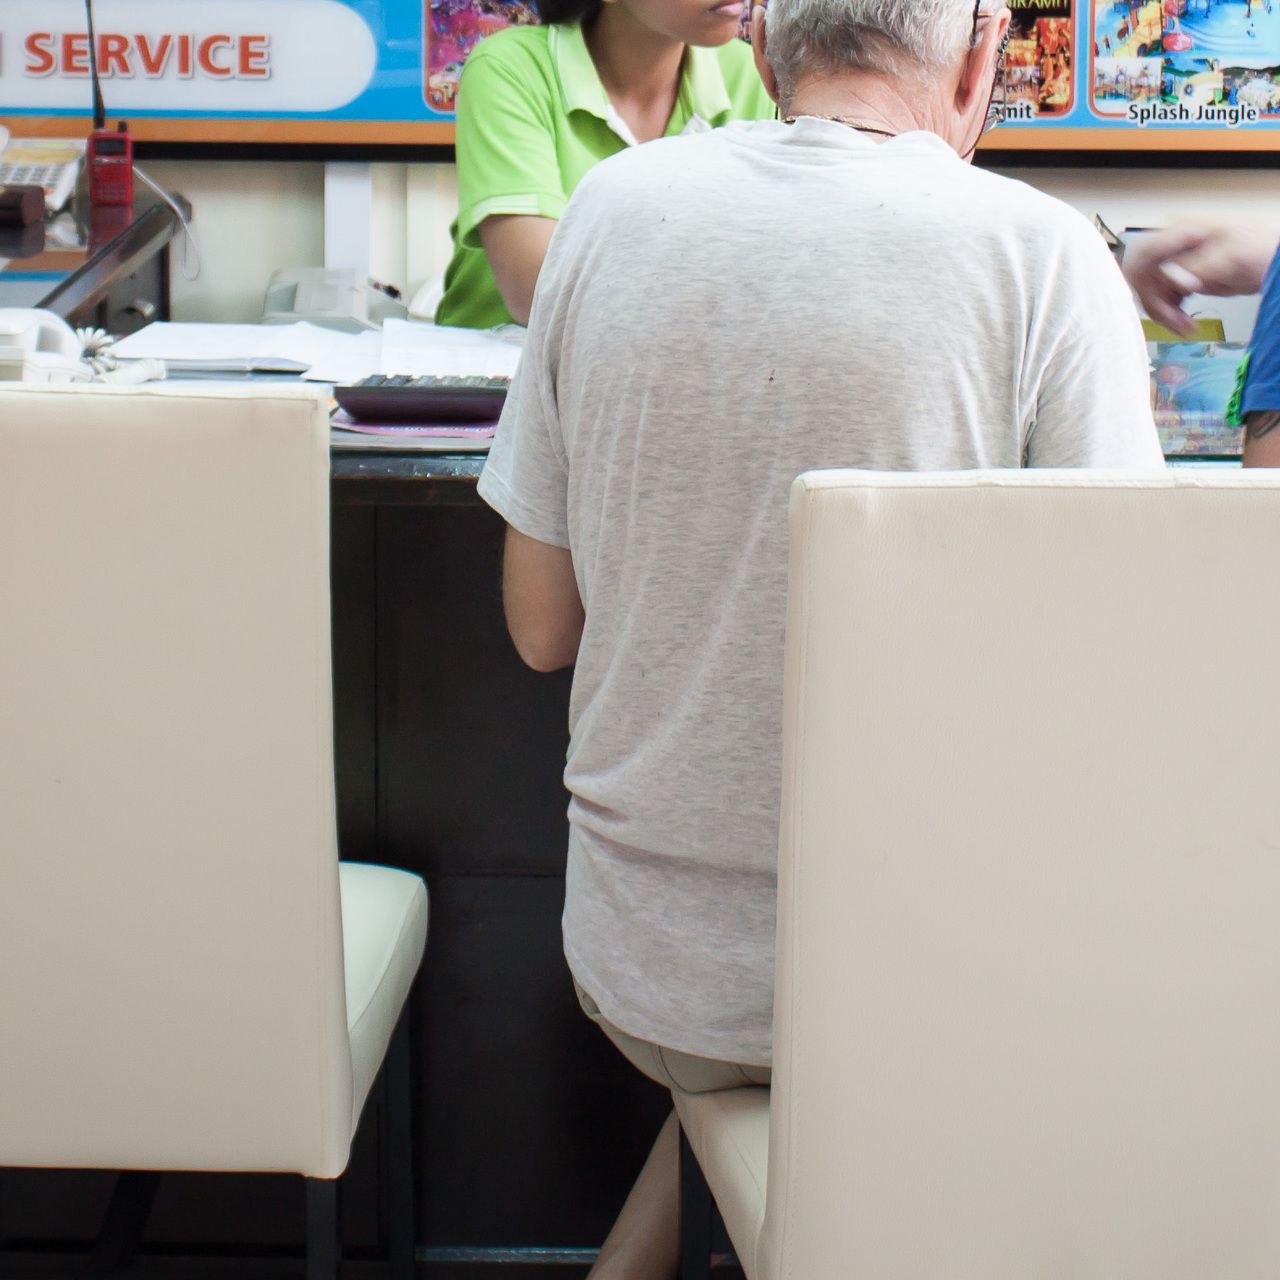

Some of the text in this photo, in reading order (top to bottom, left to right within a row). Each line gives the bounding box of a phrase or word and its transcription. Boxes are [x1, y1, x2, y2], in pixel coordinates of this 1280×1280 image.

[24, 30, 270, 76] SERVICE
[1128, 104, 1258, 126] Splash Jungle
